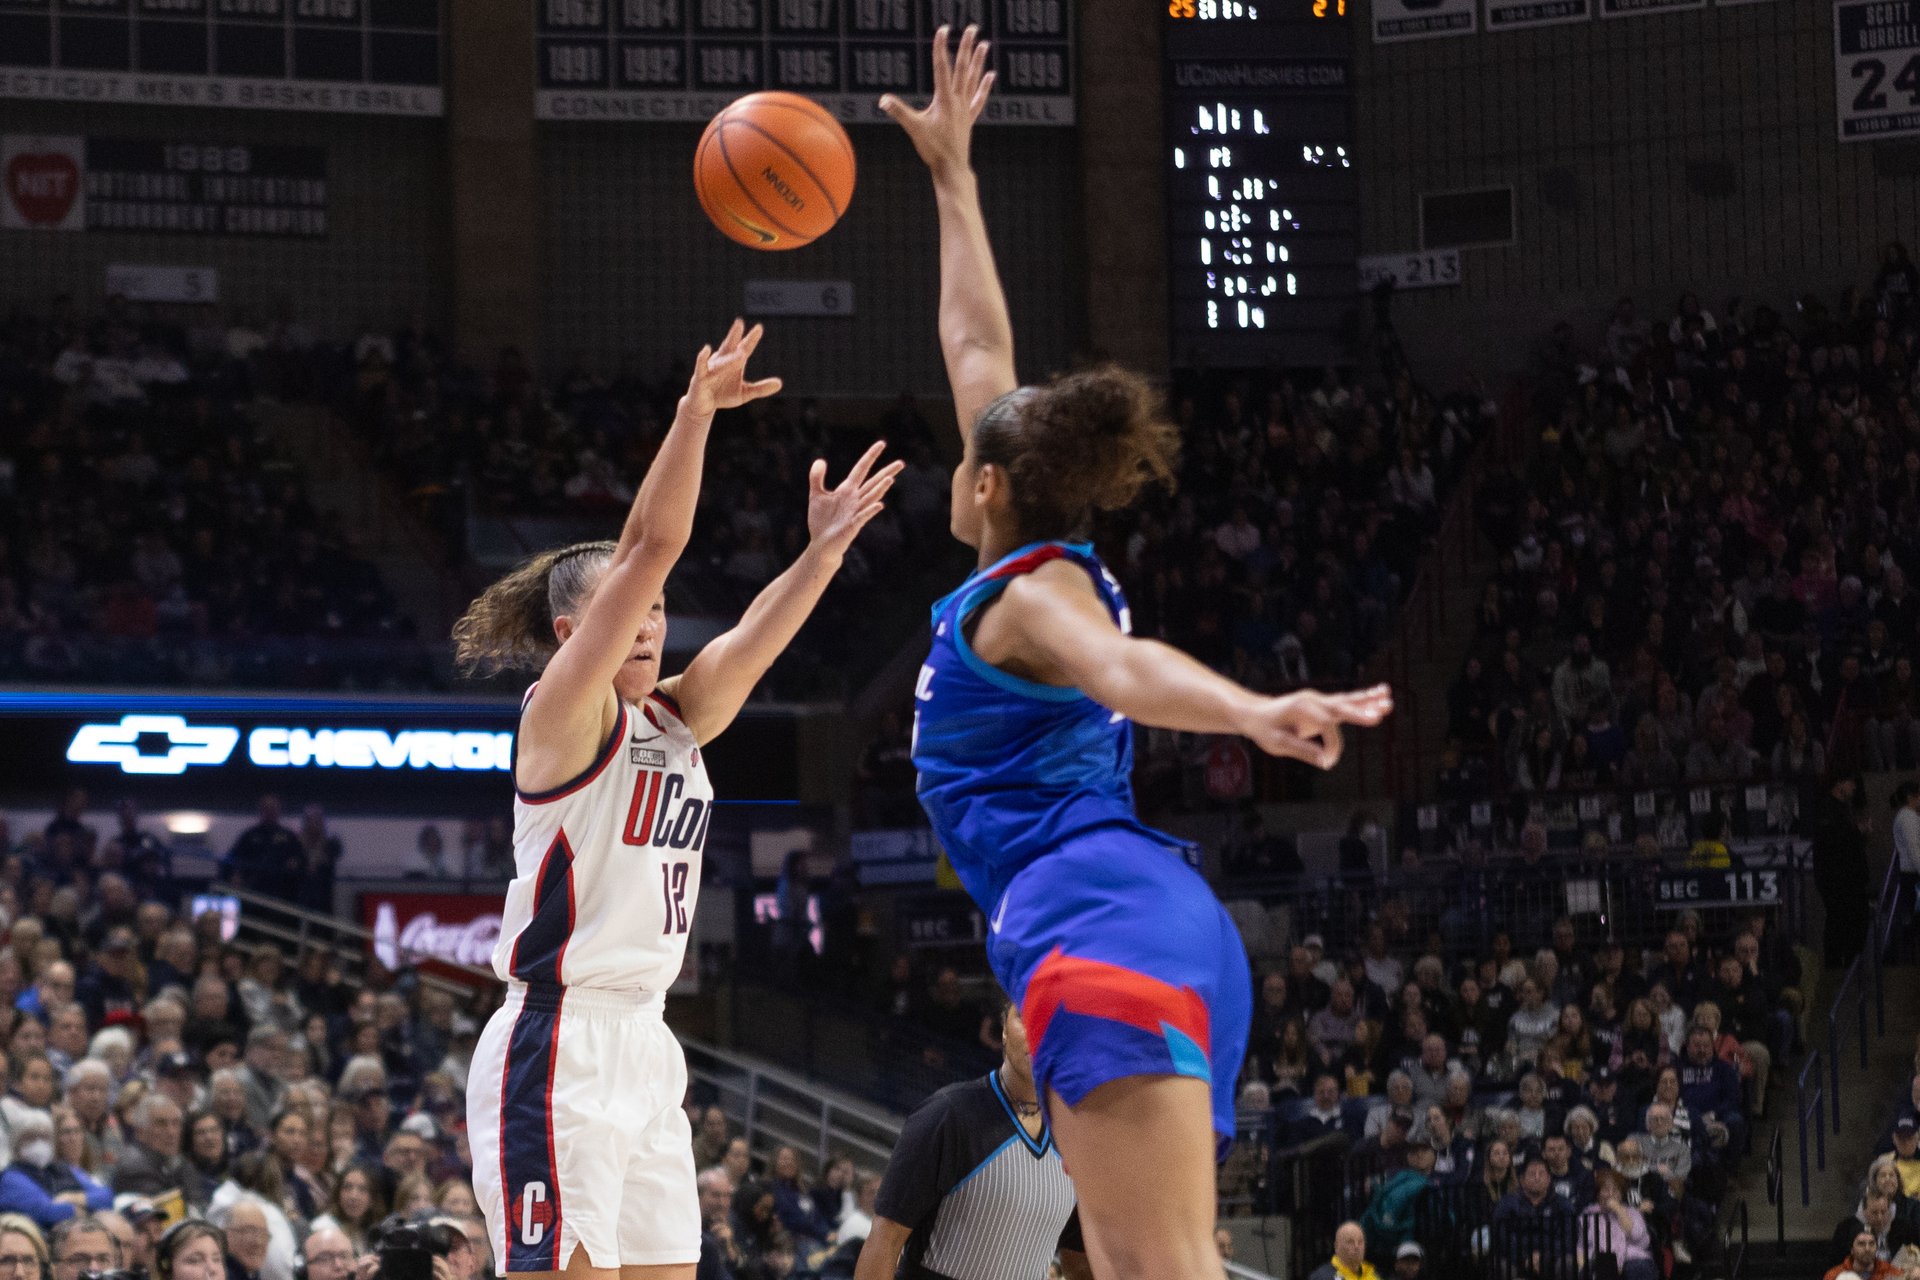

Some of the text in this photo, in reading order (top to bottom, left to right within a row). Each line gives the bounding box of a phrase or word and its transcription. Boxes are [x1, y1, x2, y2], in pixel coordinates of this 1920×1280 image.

[1866, 2, 1911, 26] SCOTT
[1859, 25, 1920, 49] BURRELL
[1851, 54, 1920, 110] 24
[238, 85, 427, 111] BASKETBALL
[1407, 254, 1457, 282] 213
[821, 285, 840, 310] 6
[662, 862, 689, 935] 12
[1660, 870, 1778, 902] SEC 113
[521, 1181, 546, 1245] C
